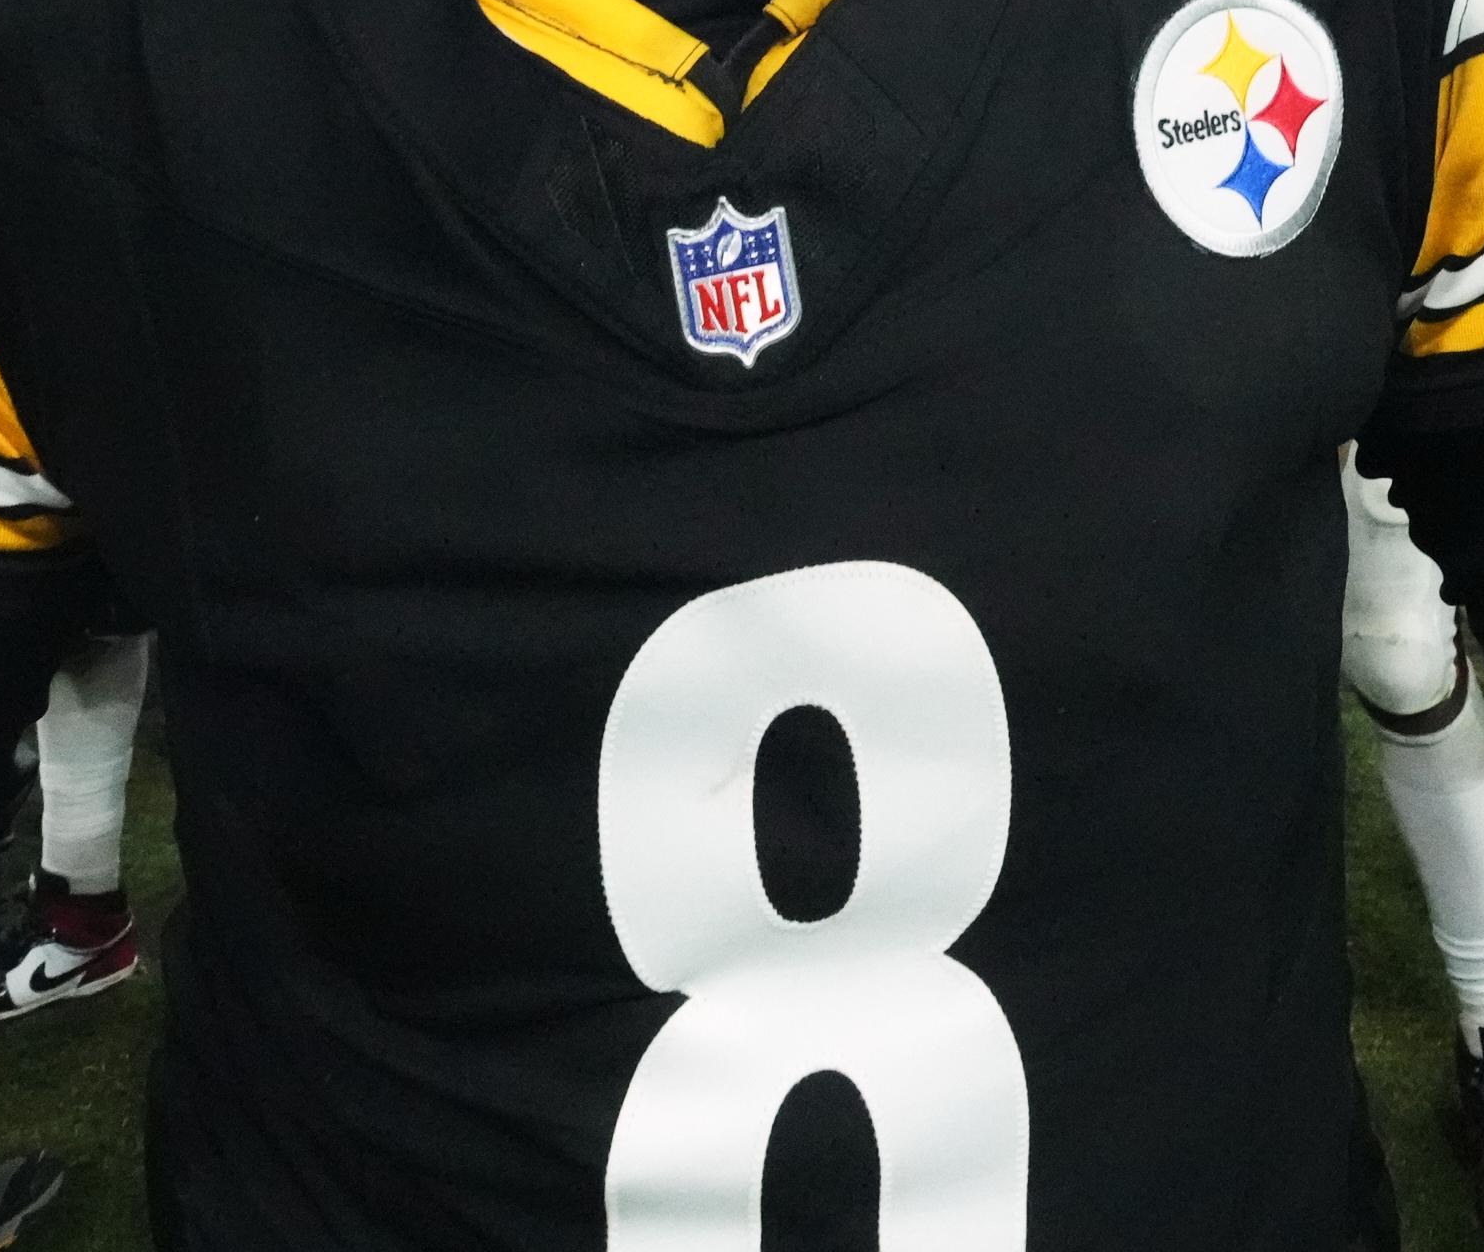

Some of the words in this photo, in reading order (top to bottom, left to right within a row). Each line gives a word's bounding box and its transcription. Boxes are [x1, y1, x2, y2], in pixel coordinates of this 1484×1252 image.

[1157, 108, 1243, 150] Steelers
[696, 271, 780, 335] NFL
[597, 559, 1030, 1252] 8
